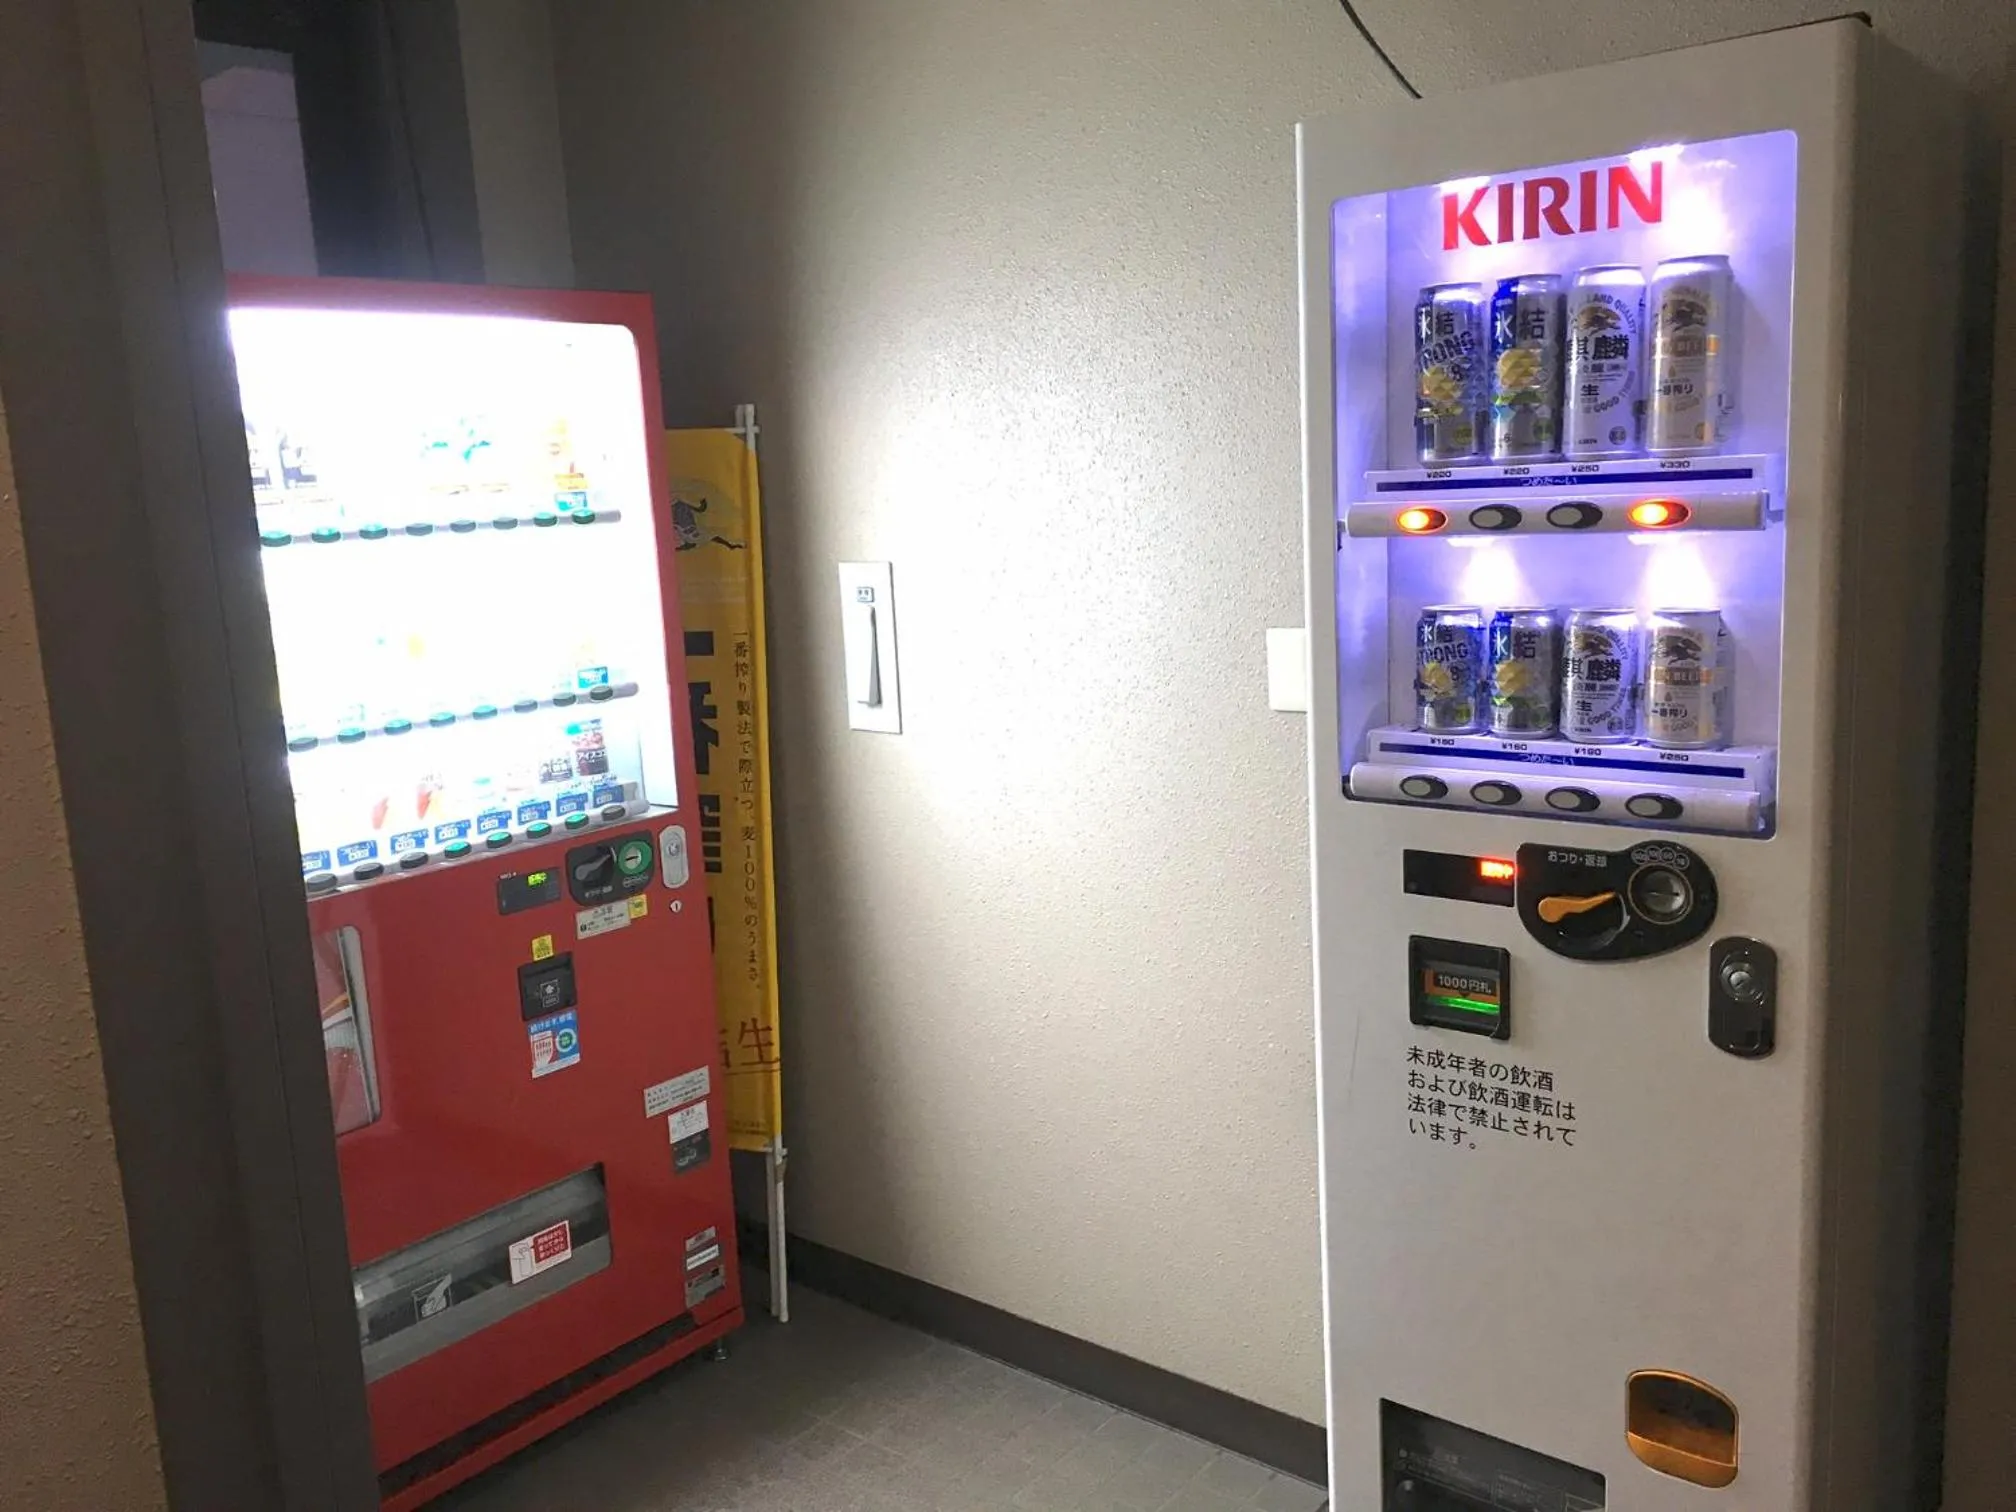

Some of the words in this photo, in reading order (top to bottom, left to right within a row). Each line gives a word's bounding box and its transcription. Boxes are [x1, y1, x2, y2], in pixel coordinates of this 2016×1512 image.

[1441, 161, 1663, 251] KIRIN
[1660, 460, 1691, 470] ¥330
[1439, 975, 1492, 994] 1000円札
[1406, 1045, 1554, 1092] 未成年者の飲酒
[1407, 1069, 1577, 1121] および飲酒運転は
[1407, 1092, 1577, 1147] 法律で禁止されて
[1409, 1118, 1477, 1150] います。
